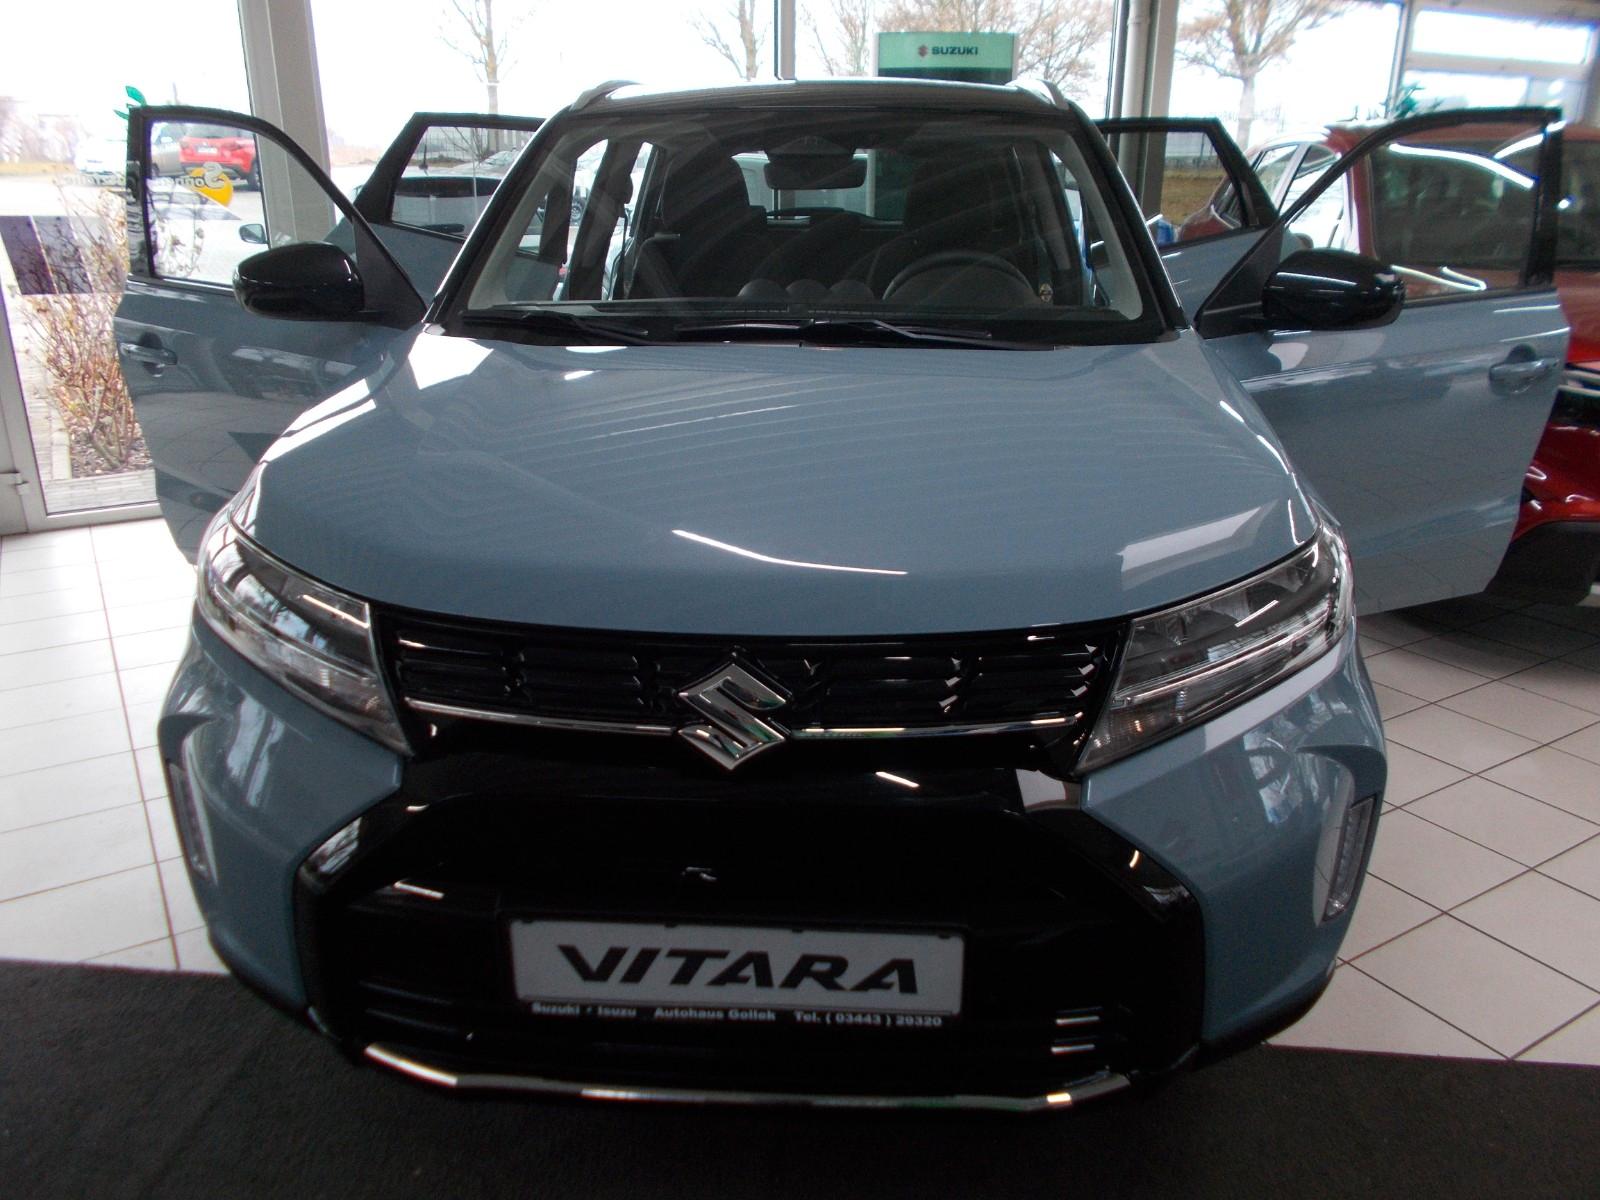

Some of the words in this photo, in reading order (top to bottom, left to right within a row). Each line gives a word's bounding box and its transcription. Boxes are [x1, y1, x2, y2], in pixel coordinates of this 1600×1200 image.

[931, 46, 978, 56] SUZUKI
[557, 944, 918, 994] VITARA
[654, 1007, 724, 1019] Autohaus
[794, 1010, 821, 1023] Tel.
